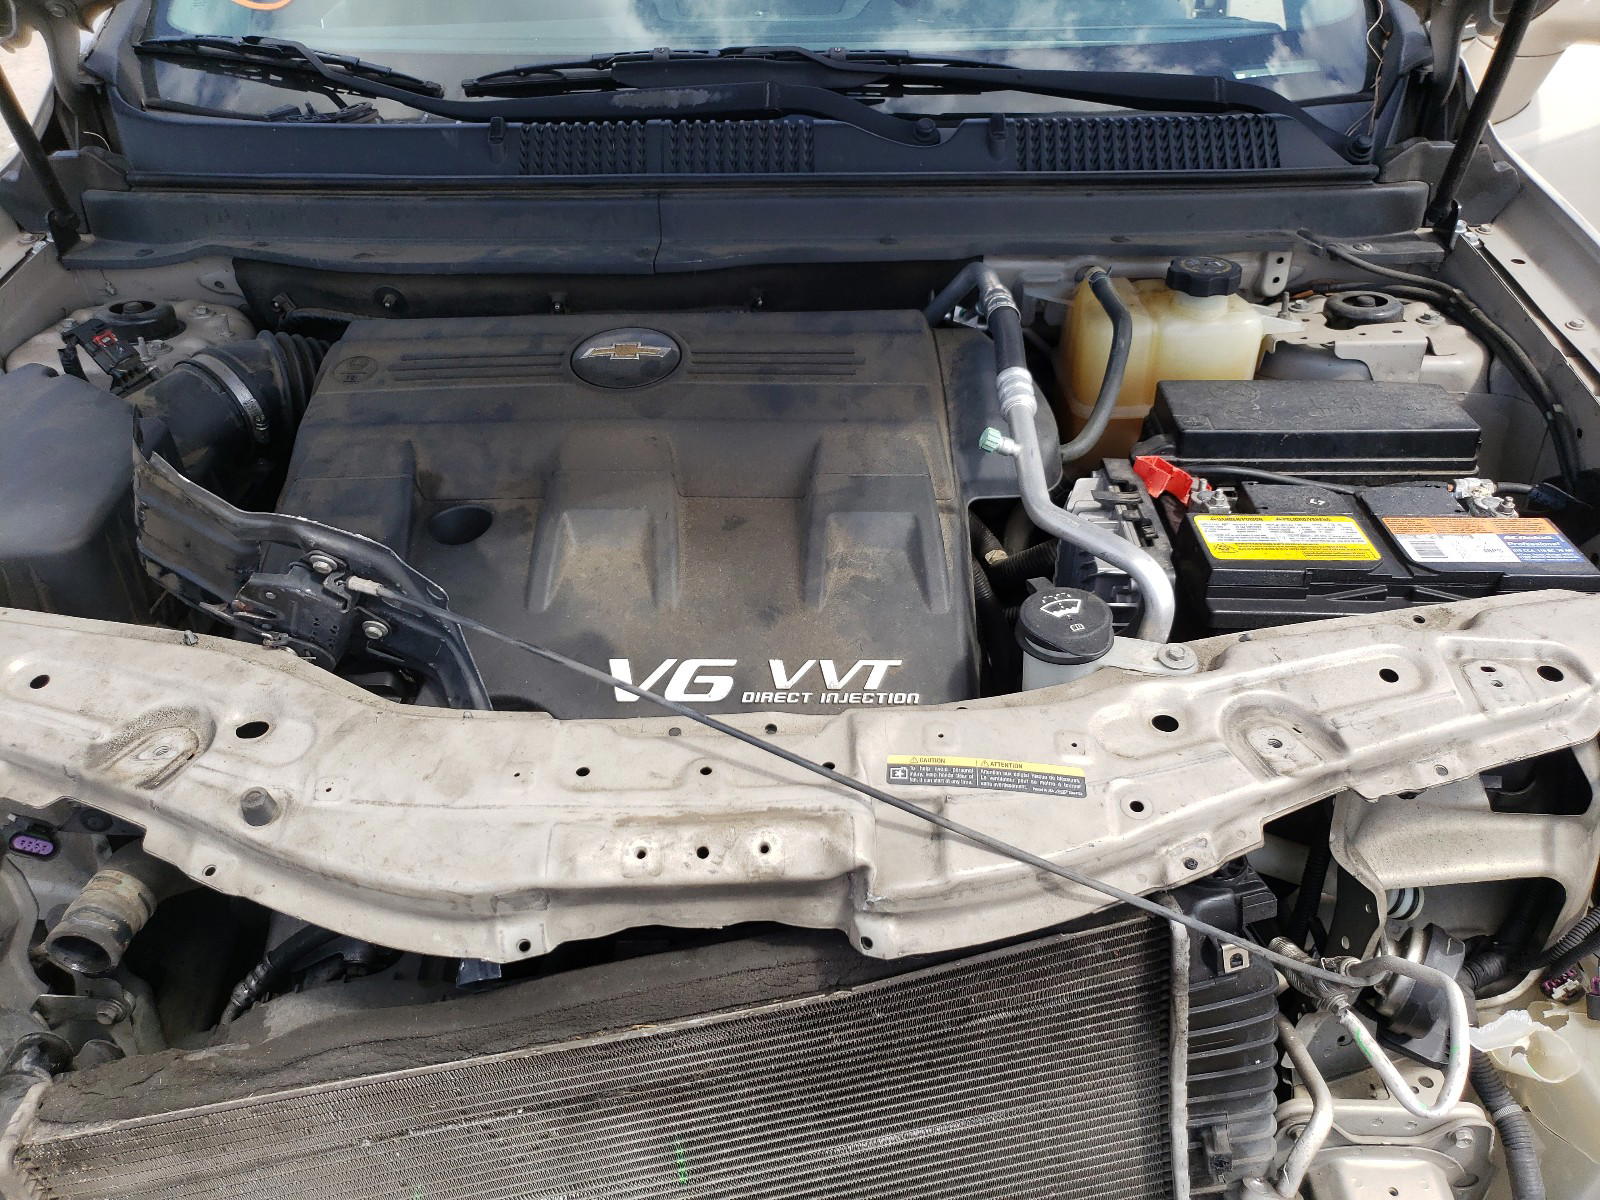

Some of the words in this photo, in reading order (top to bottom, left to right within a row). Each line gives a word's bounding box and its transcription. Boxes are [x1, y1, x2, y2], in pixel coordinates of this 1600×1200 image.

[609, 659, 738, 702] V6
[768, 659, 903, 690] VVT
[741, 691, 814, 704] DIRECT
[820, 692, 920, 705] INJECTION
[990, 761, 1023, 769] ATTENTION
